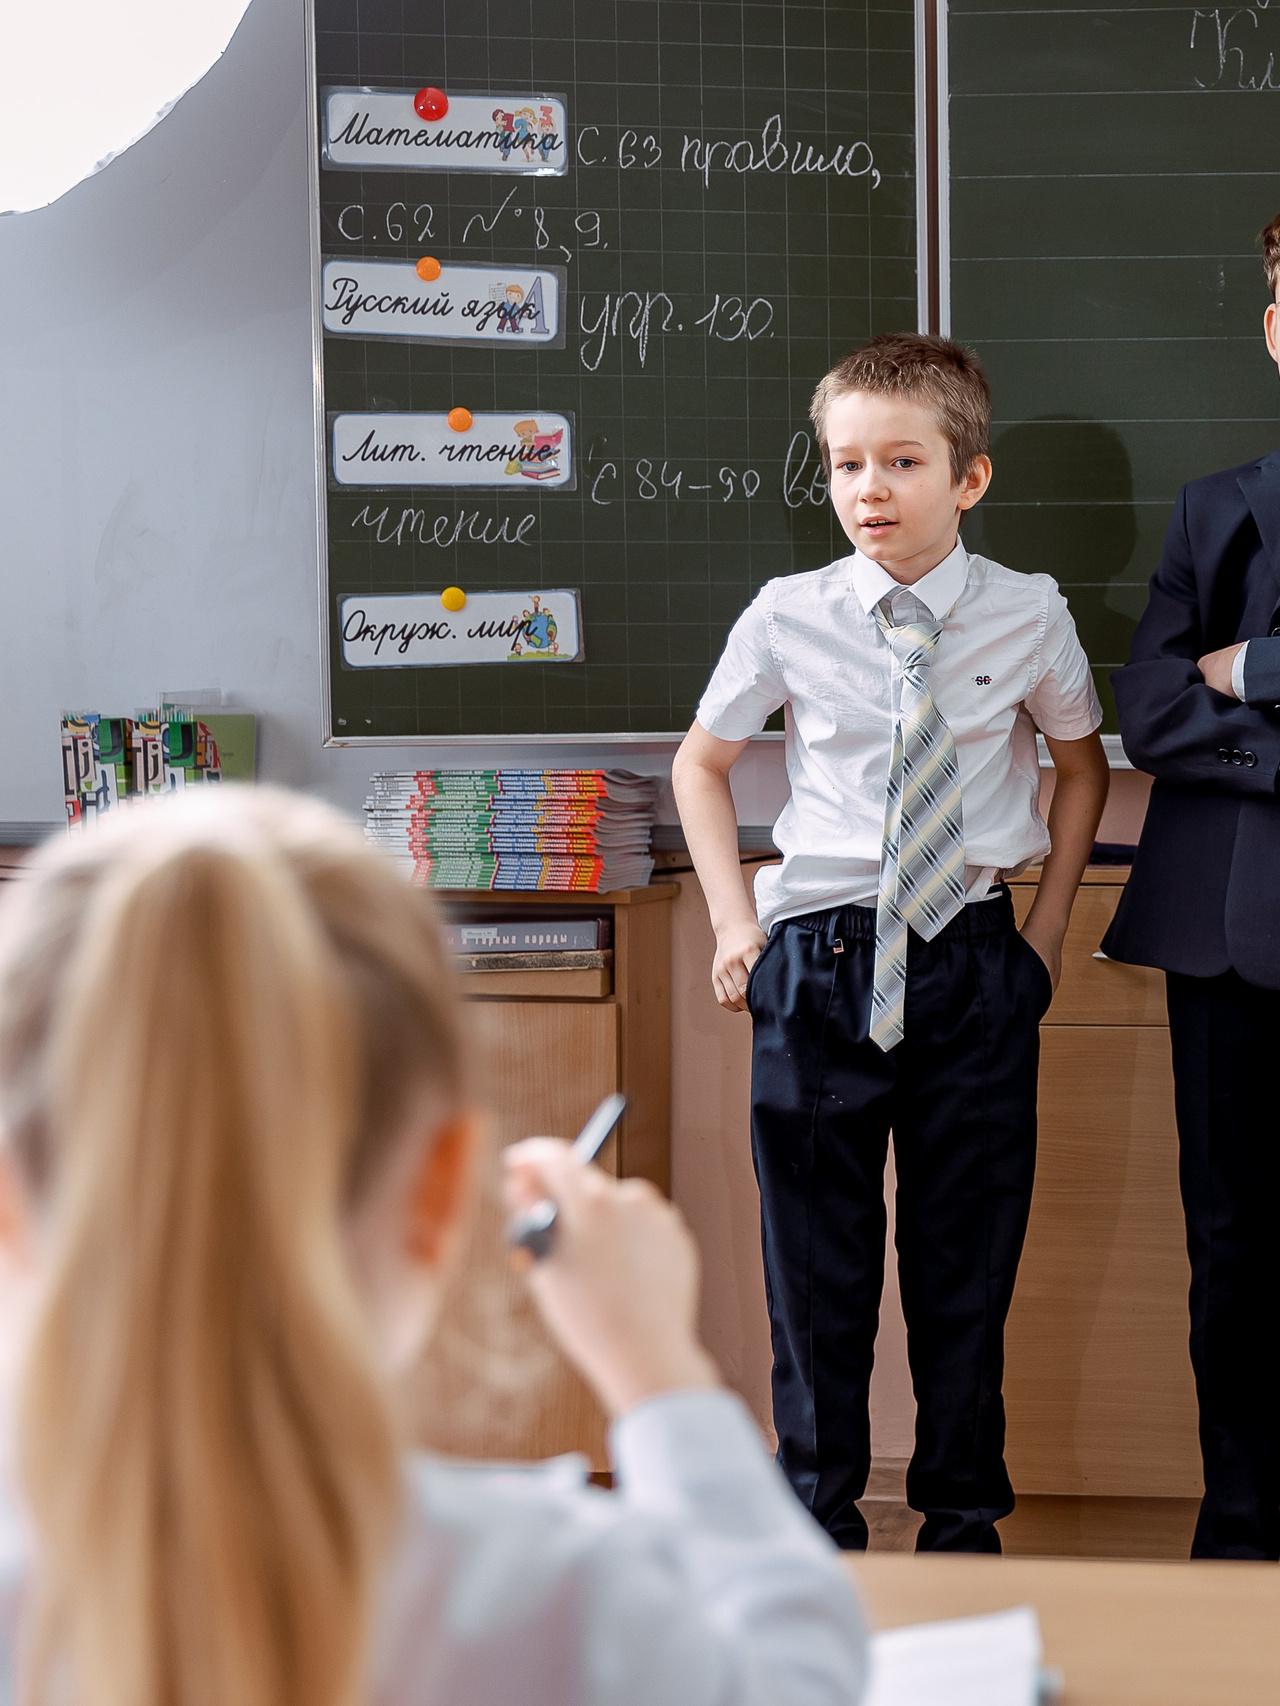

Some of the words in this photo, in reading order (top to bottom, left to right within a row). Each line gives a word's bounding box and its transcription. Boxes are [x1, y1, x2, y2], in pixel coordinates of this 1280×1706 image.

[329, 111, 564, 153] Математика
[323, 277, 454, 325] Русский
[460, 299, 541, 333] язык
[342, 429, 427, 462] Лит.
[438, 441, 558, 462] чтение
[351, 505, 537, 547] чтение
[342, 609, 457, 647] Окруж.
[466, 616, 538, 651] мир
